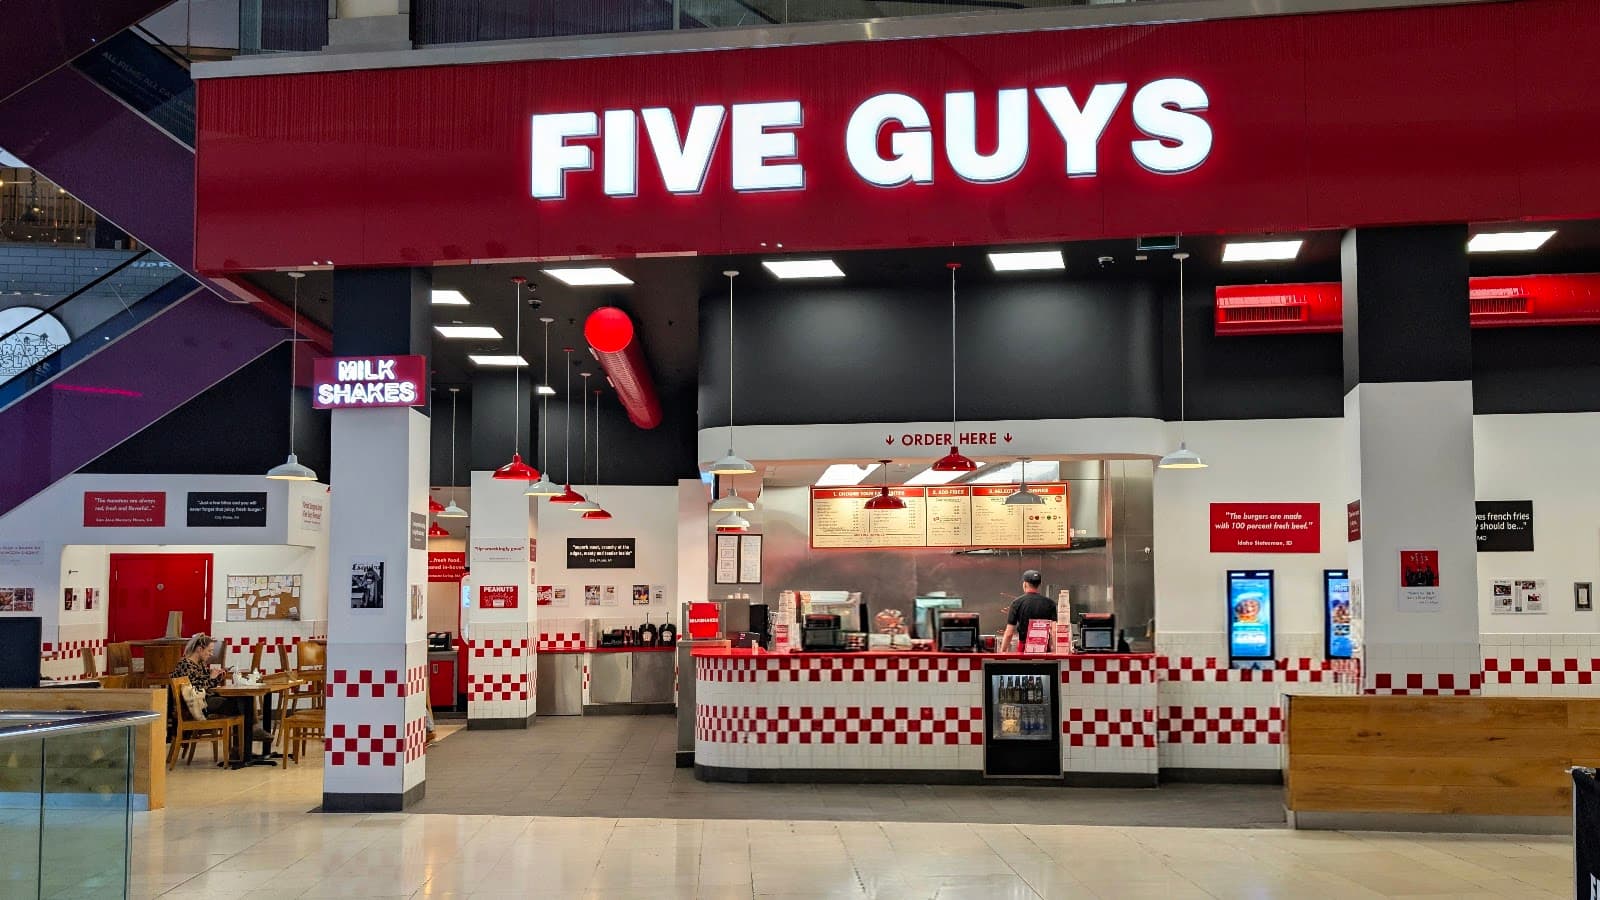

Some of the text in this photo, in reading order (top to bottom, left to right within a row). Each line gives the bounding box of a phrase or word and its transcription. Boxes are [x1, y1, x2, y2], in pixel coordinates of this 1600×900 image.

[531, 77, 1213, 199] FIVE GUYS
[337, 359, 396, 381] MILK
[317, 381, 417, 404] SHAKES
[902, 432, 997, 446] ORDER HERE
[1243, 512, 1268, 521] burgers
[1283, 512, 1302, 520] made
[1487, 511, 1512, 520] french
[1513, 511, 1530, 520] fries
[1215, 521, 1230, 529] with
[1246, 522, 1272, 530] percent
[1273, 521, 1290, 530] fresh
[1480, 521, 1505, 530] should
